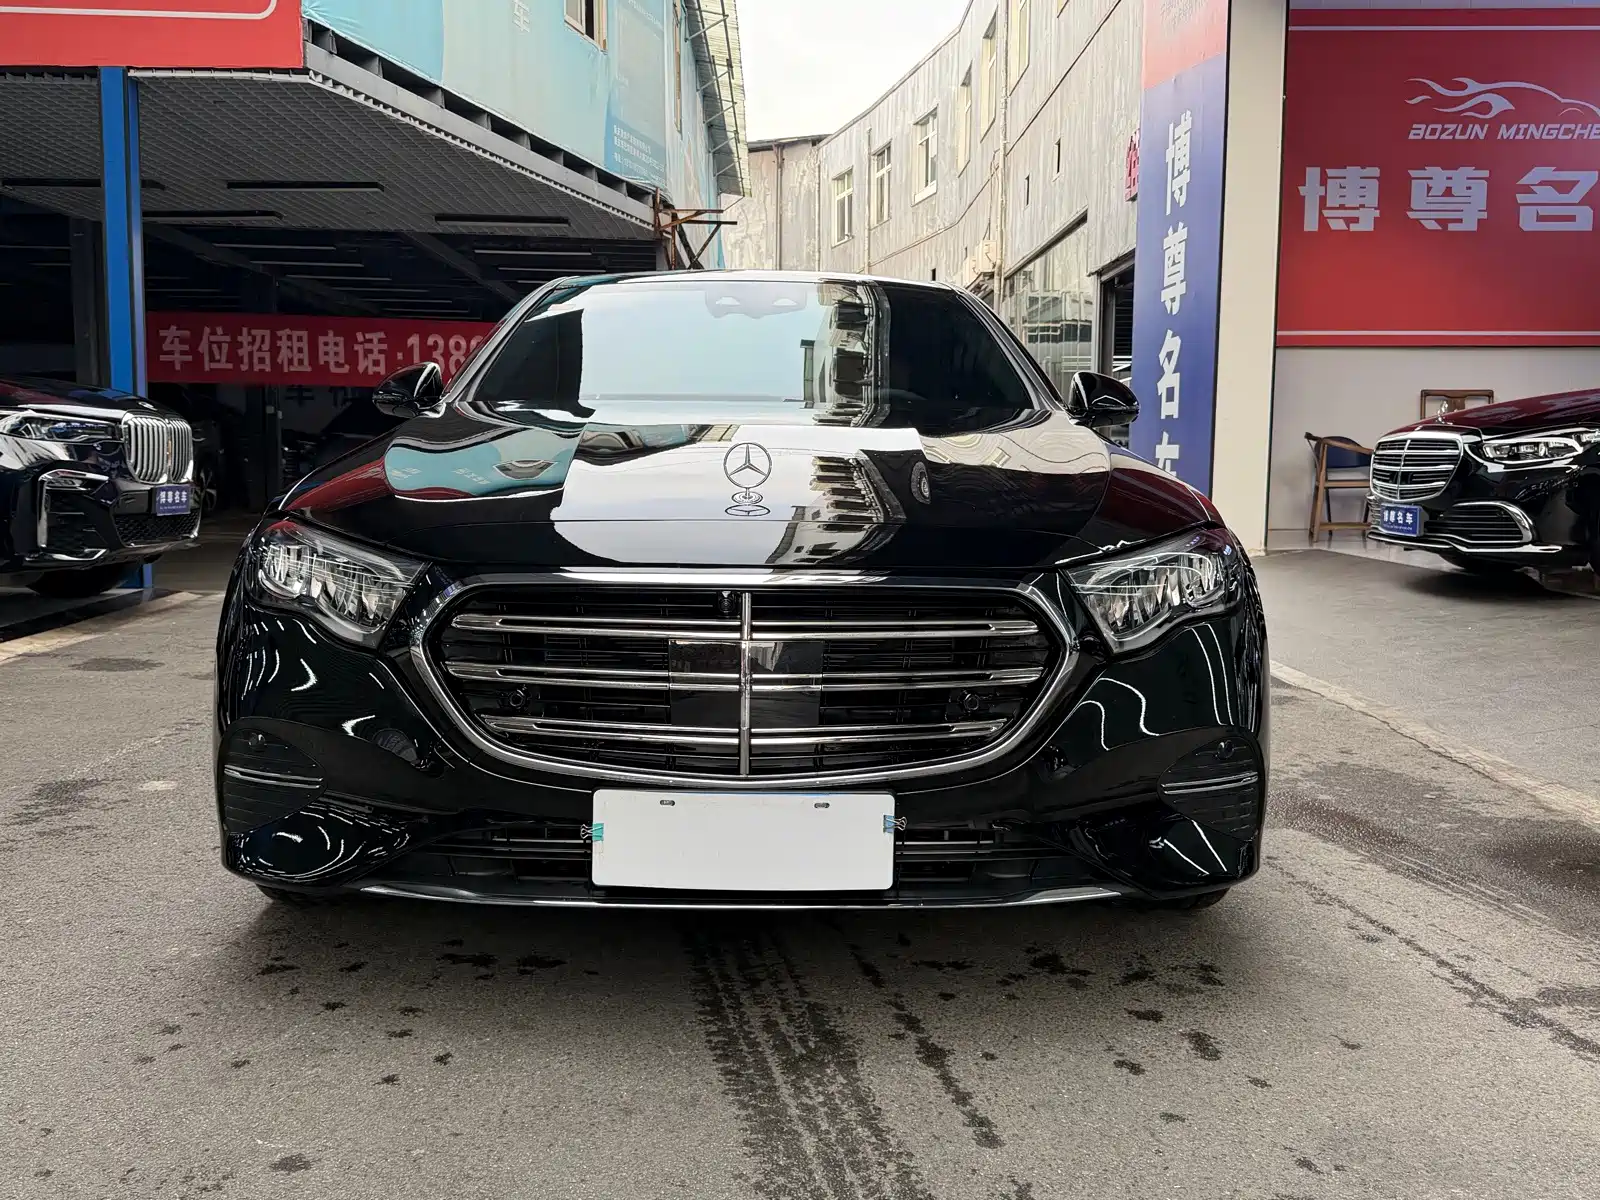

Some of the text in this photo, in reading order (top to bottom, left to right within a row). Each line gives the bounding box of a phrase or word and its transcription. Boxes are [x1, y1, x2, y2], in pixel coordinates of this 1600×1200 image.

[1408, 123, 1600, 140] BOZUN MINGCHE
[1298, 166, 1600, 232] 博尊名
